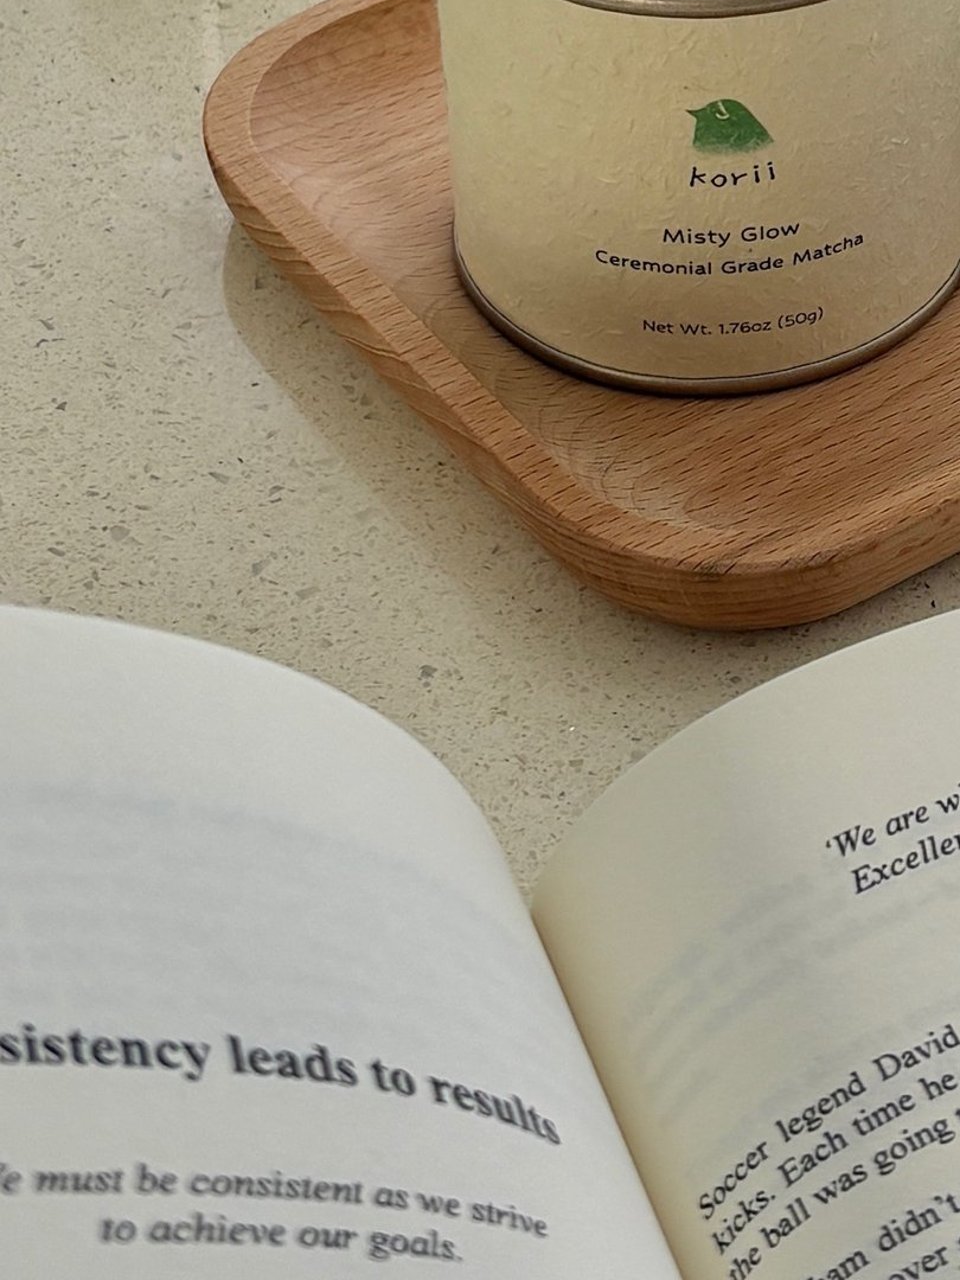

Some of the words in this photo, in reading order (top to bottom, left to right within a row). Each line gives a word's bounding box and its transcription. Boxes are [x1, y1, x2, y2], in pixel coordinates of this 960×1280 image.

[688, 161, 776, 189] korii
[595, 249, 712, 276] Ceremonial
[720, 256, 785, 275] Grade
[792, 233, 864, 267] Matcha
[662, 227, 732, 249] Misty
[740, 222, 800, 243] Glow
[642, 319, 675, 336] Net
[679, 322, 713, 336] Wt.
[717, 320, 773, 336] 1.76oz
[777, 305, 824, 330] (50g)
[885, 805, 931, 837] are
[223, 1033, 360, 1089] leads
[366, 1057, 418, 1098] to
[425, 1075, 563, 1146] results
[698, 1141, 769, 1221] Soccer
[774, 1070, 867, 1144] legend
[711, 1190, 777, 1256] kicks.
[776, 1130, 850, 1189] Each
[851, 1094, 917, 1137] time
[917, 1073, 959, 1102] he
[31, 1169, 125, 1195] must
[133, 1162, 179, 1197] be
[184, 1169, 364, 1206] consistent
[370, 1186, 410, 1211] as
[413, 1192, 462, 1220] we
[468, 1201, 549, 1239] strive
[758, 1196, 812, 1249] ball
[812, 1163, 869, 1205] was
[872, 1118, 956, 1177] going
[97, 1217, 138, 1246] to
[144, 1211, 287, 1248] achieve
[294, 1226, 360, 1251] our
[366, 1228, 464, 1263] goals.
